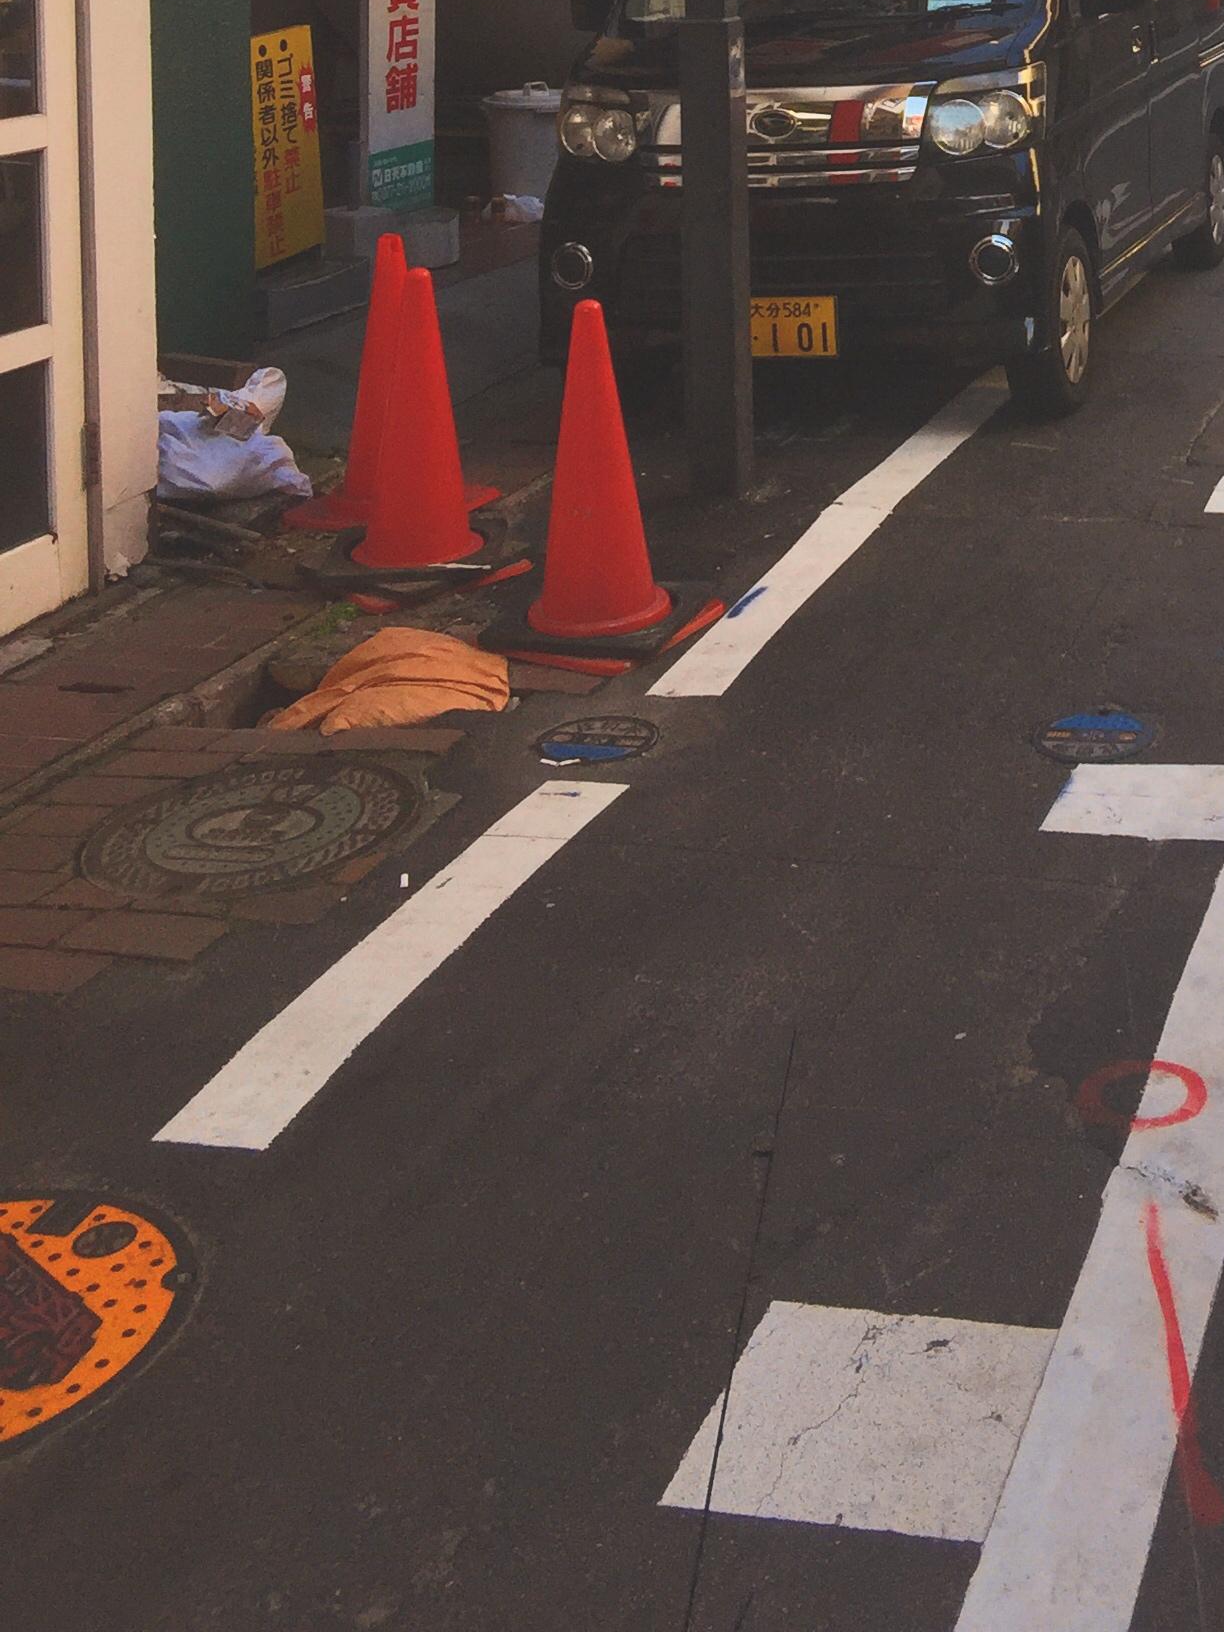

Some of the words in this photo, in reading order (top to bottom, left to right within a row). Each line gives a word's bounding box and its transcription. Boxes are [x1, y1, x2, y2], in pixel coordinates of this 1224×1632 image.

[255, 57, 287, 259] 関係者以外駐車禁止
[276, 52, 302, 196] ゴミ捨て禁止
[300, 73, 315, 121] 警告
